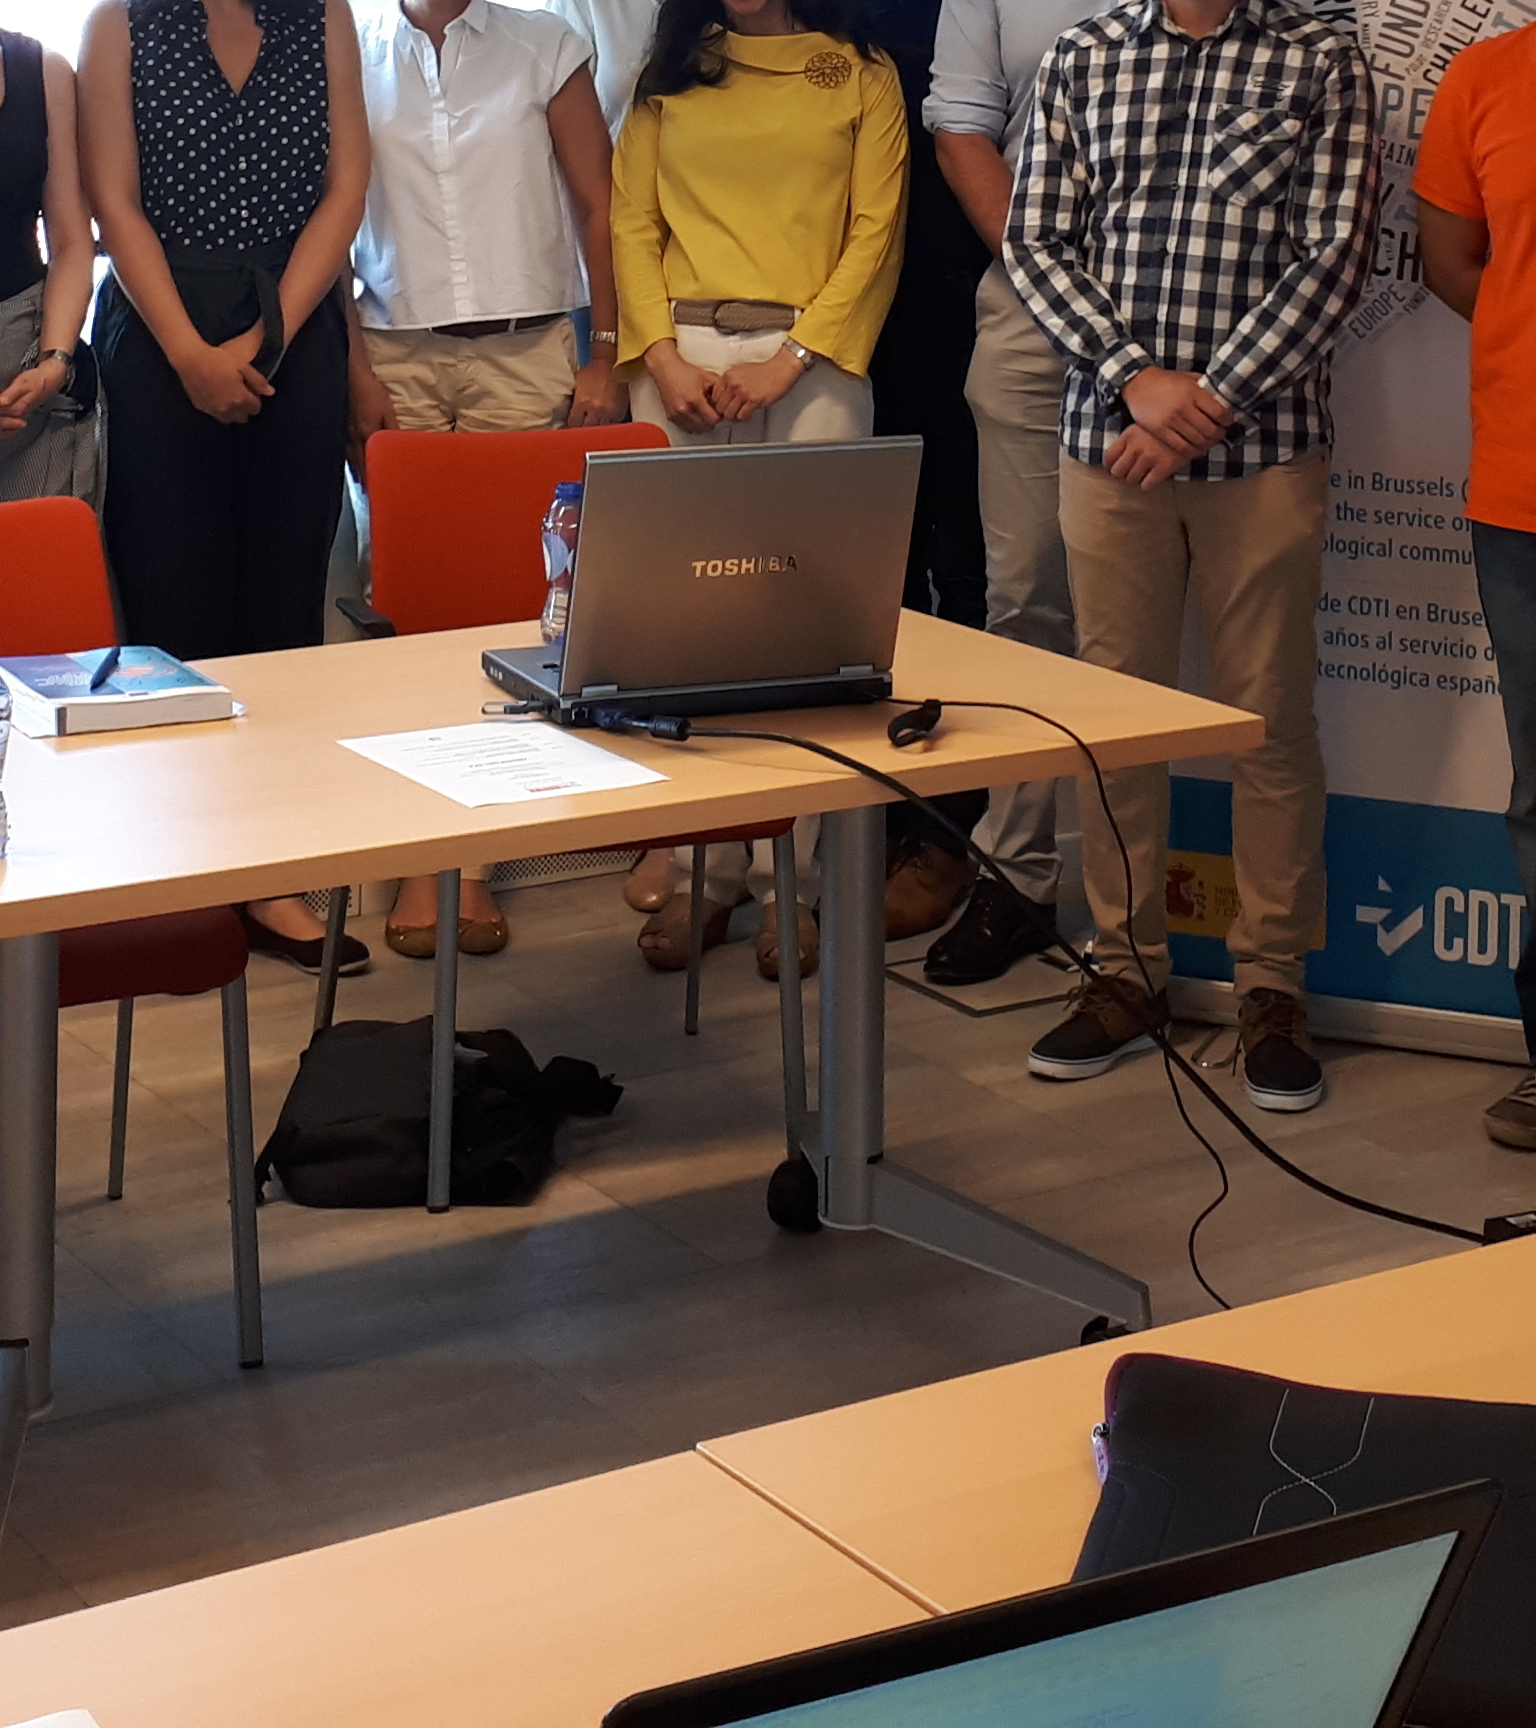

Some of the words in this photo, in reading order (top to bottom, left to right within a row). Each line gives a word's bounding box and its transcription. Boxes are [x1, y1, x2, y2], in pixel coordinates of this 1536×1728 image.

[1422, 0, 1453, 50] RESEARCH
[1348, 283, 1406, 339] EUROPE
[1348, 469, 1365, 490] in
[1371, 472, 1455, 498] Brussels
[1335, 501, 1367, 522] the
[1373, 507, 1445, 530] service
[691, 554, 798, 578] TOSHIBA
[1318, 592, 1341, 613] de
[1348, 595, 1390, 618] CDTI
[1395, 604, 1420, 621] en
[1427, 602, 1486, 627] Bruse
[1323, 627, 1370, 649] años
[1376, 631, 1393, 651] al
[1399, 636, 1477, 660] servicio
[1317, 659, 1430, 690] tecnológica
[1433, 885, 1527, 969] CDT
